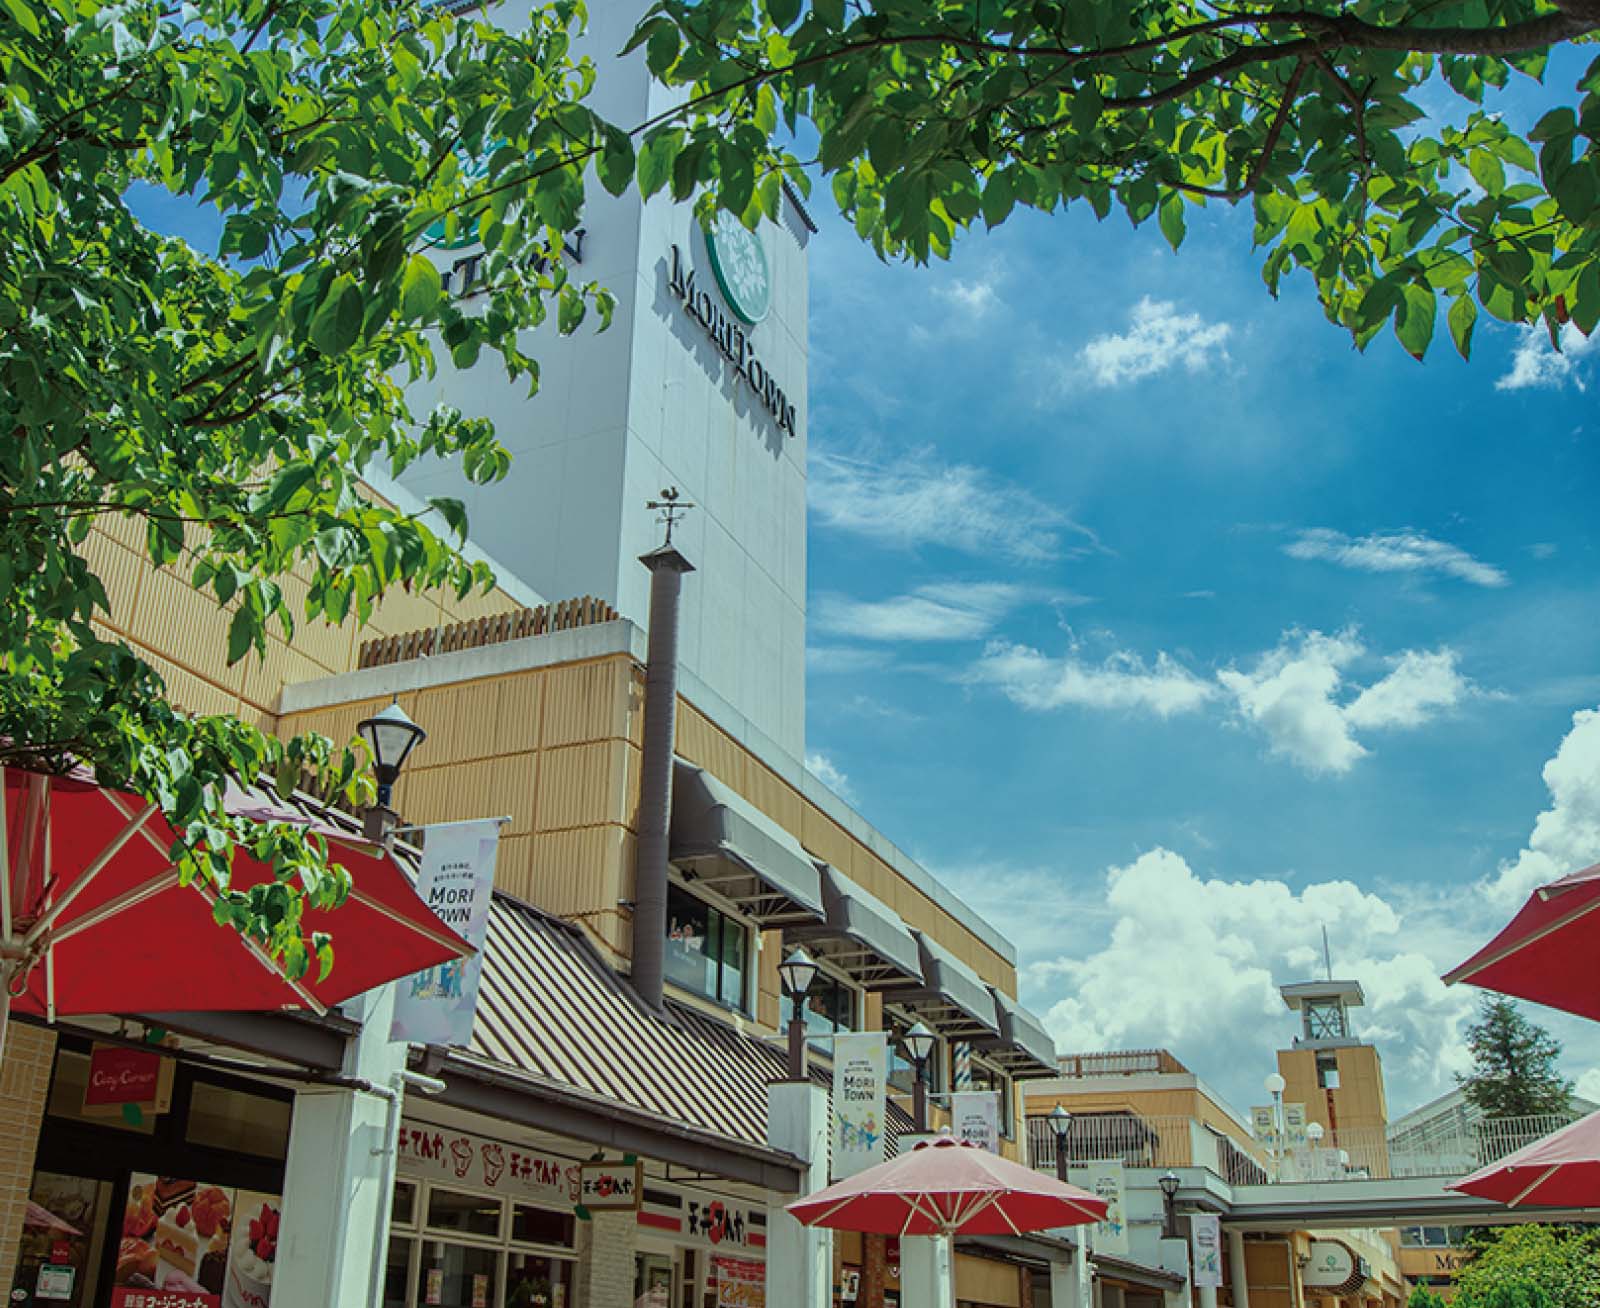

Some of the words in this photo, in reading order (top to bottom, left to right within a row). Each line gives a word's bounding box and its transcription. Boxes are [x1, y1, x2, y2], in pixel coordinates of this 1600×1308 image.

[428, 886, 475, 904] MORI
[843, 1076, 875, 1088] MORI
[843, 1089, 875, 1101] TOWN
